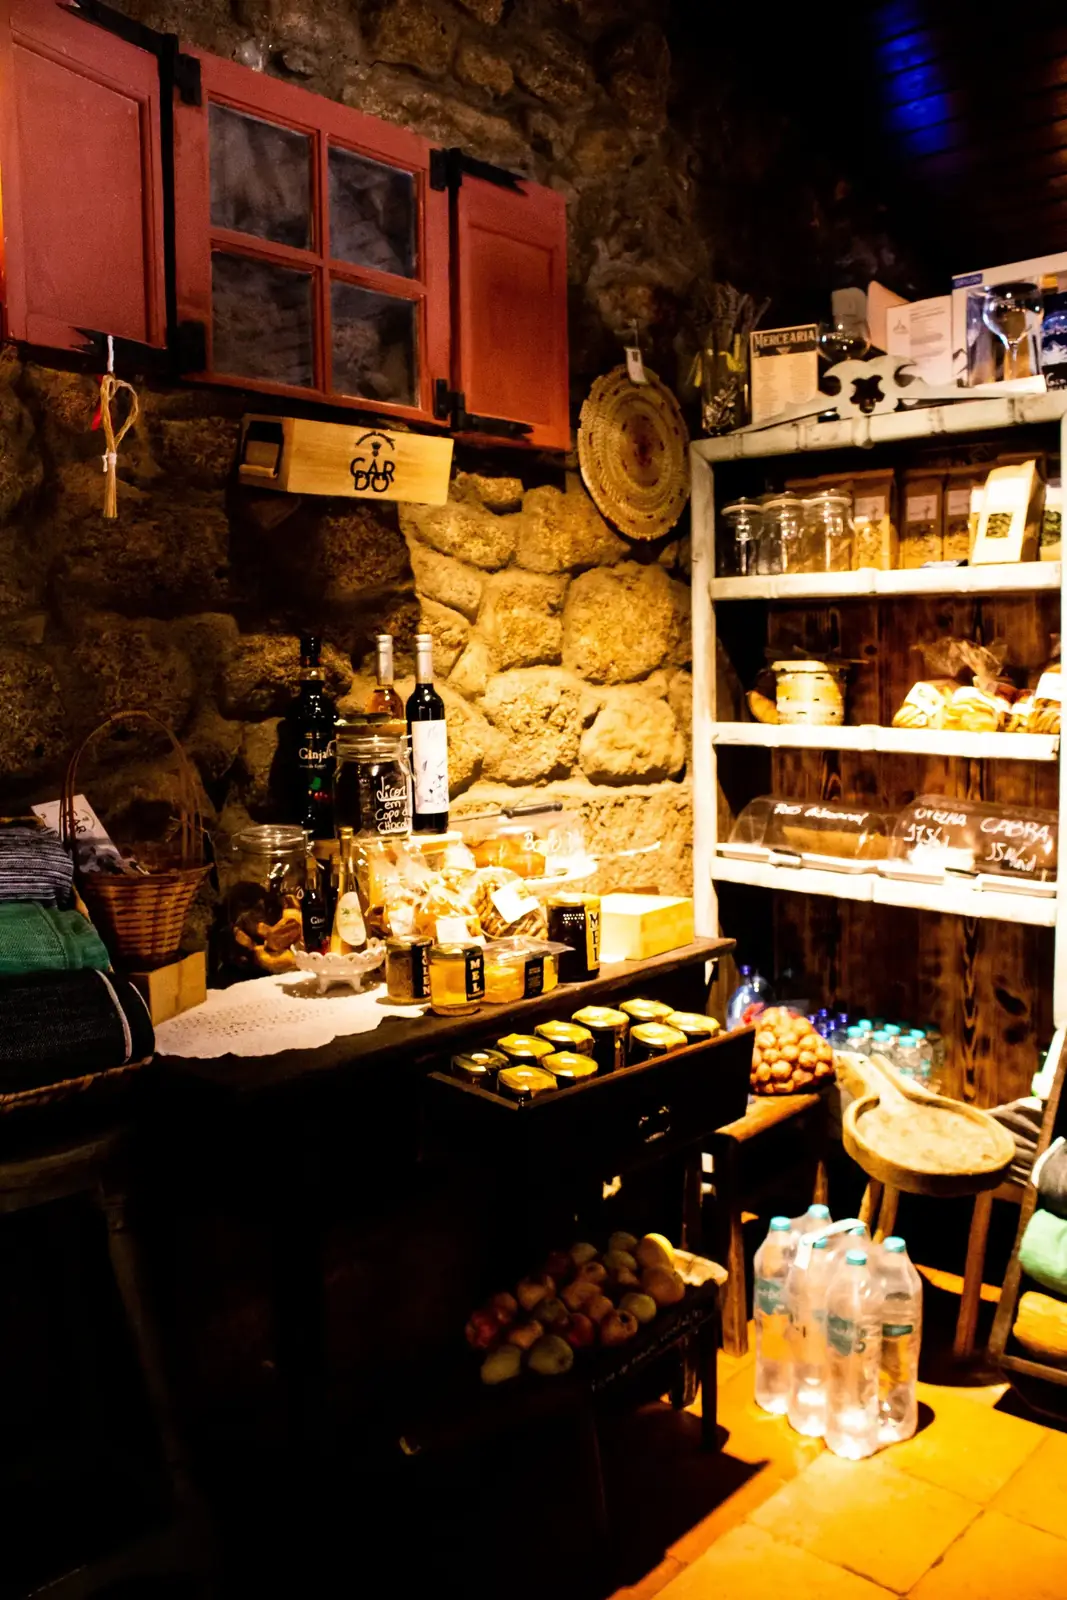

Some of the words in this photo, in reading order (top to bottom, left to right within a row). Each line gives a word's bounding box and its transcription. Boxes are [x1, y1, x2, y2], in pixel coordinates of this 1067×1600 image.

[753, 329, 815, 349] MERCEARIA
[354, 470, 389, 493] DO
[980, 817, 1050, 842] CABRA
[470, 958, 481, 993] MEL
